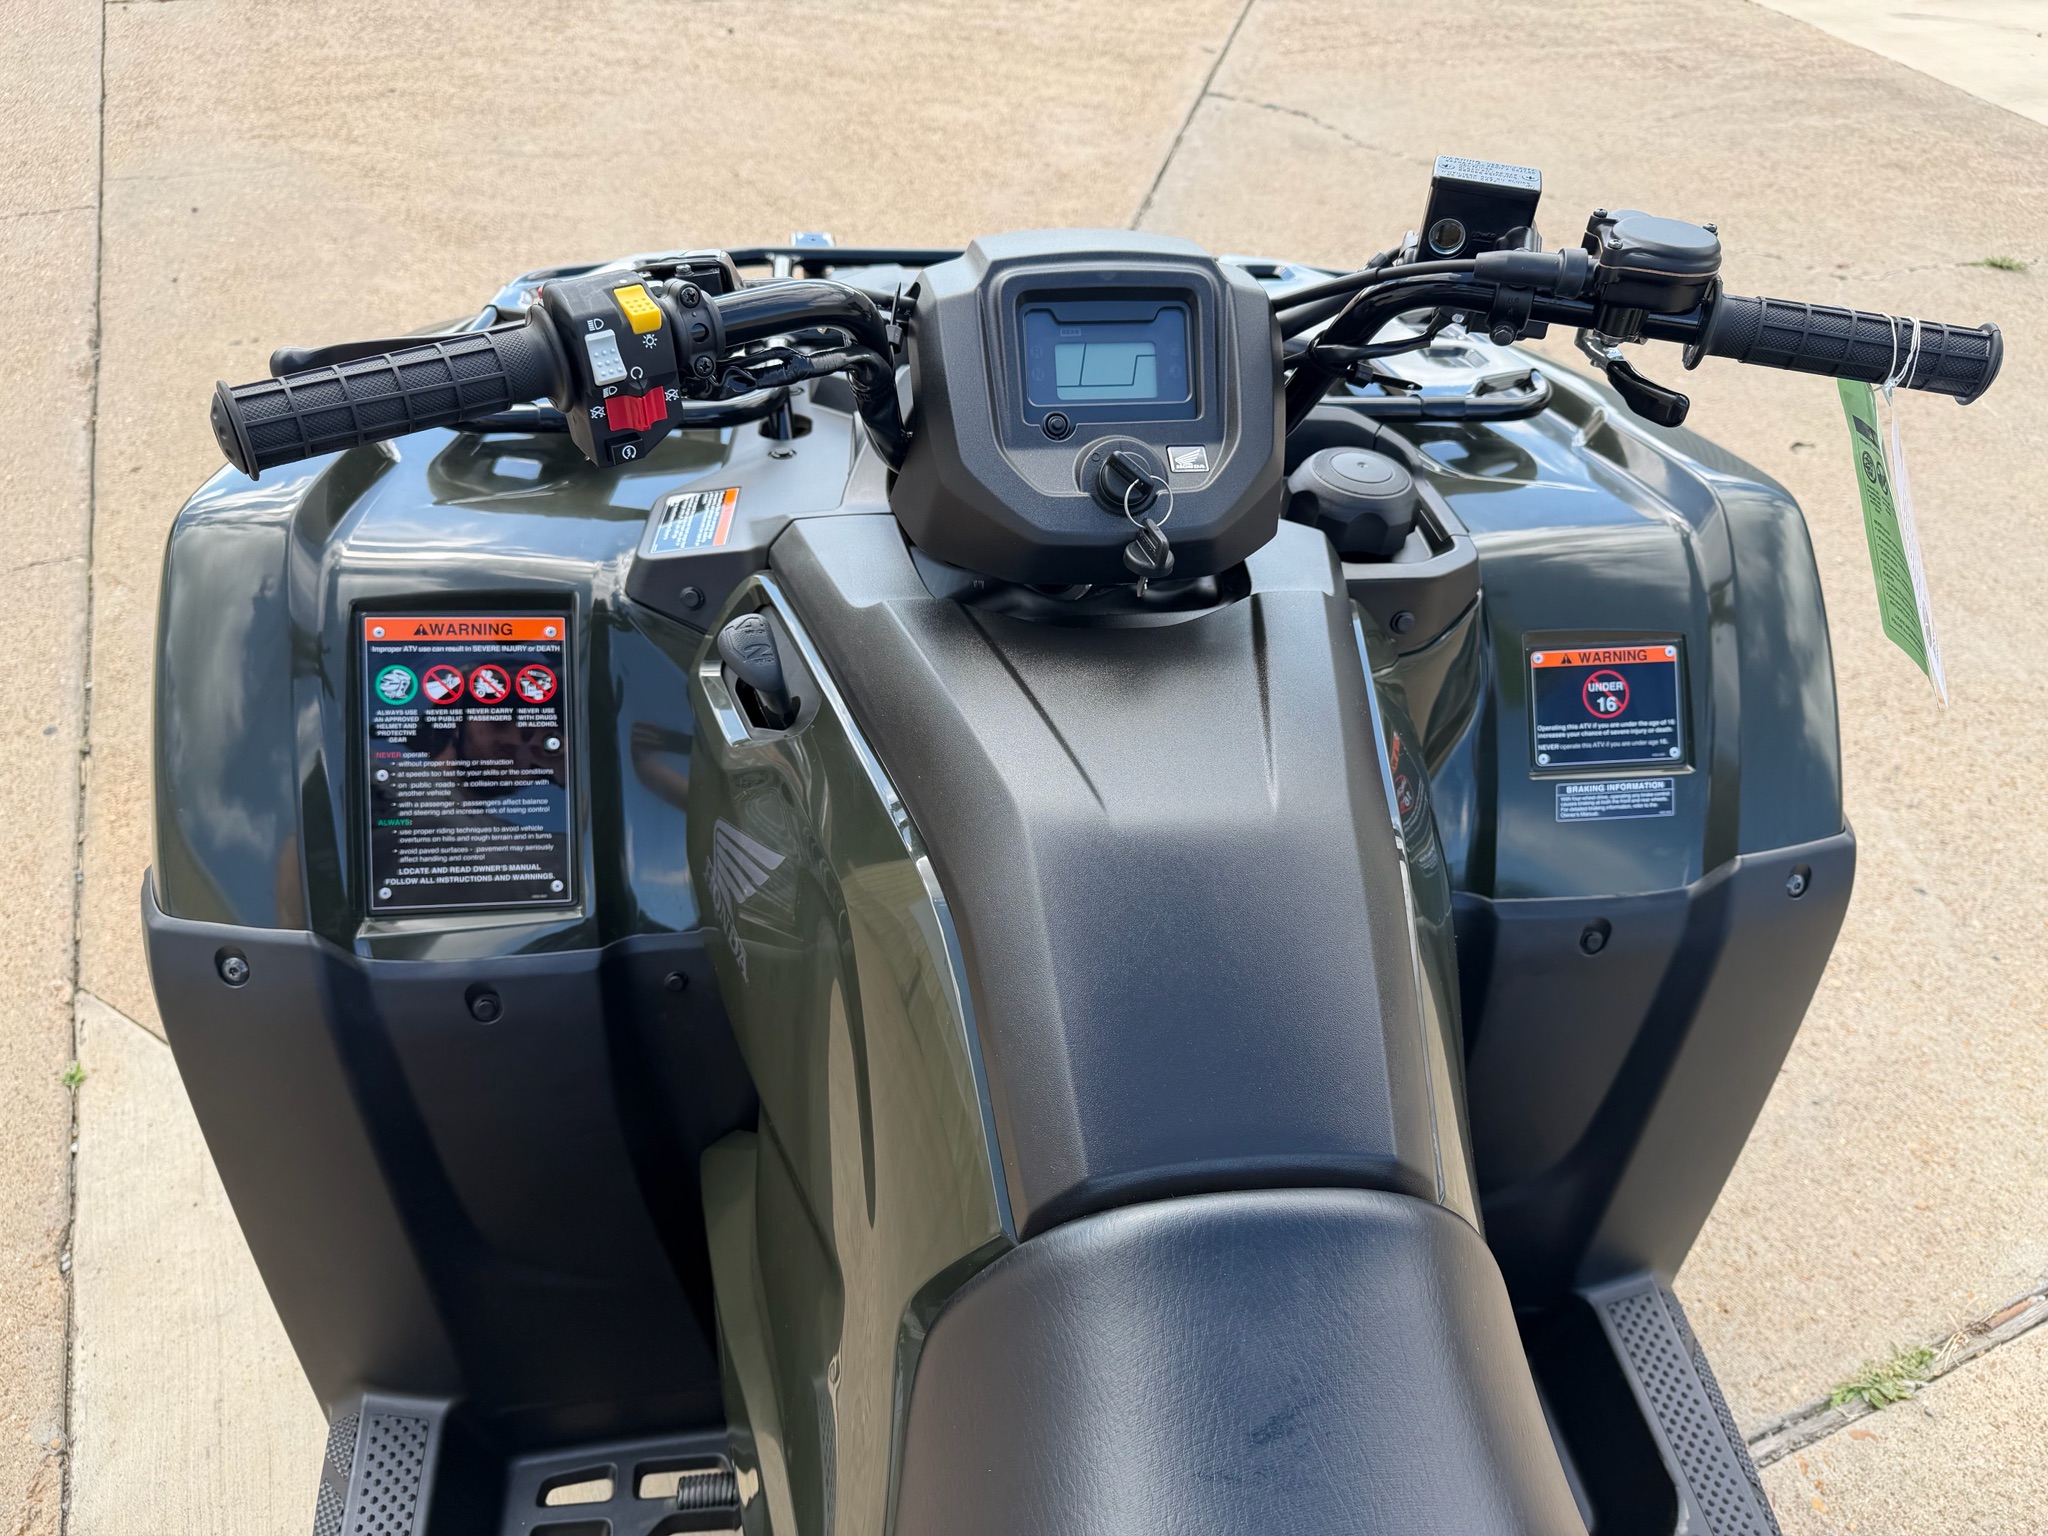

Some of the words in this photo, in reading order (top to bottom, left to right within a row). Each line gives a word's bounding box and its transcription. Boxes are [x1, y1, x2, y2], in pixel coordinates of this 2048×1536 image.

[429, 623, 513, 636] WARNING
[1578, 649, 1648, 663] WARNING
[1588, 681, 1624, 692] UNDER
[1597, 696, 1618, 712] 16
[405, 770, 430, 778] speeds
[410, 781, 432, 789] public
[1566, 784, 1605, 794] BRAKING
[1606, 781, 1665, 791] INFORMATION
[413, 809, 440, 817] steering
[456, 826, 492, 834] techniques
[471, 834, 490, 842] rough
[419, 847, 440, 855] paved
[475, 845, 508, 853] pavement
[525, 844, 554, 852] seriously
[419, 855, 448, 863] handling
[398, 867, 430, 875] LOCATE
[436, 875, 493, 884] INSTRUCTIONS
[512, 872, 556, 880] WARNINGS.
